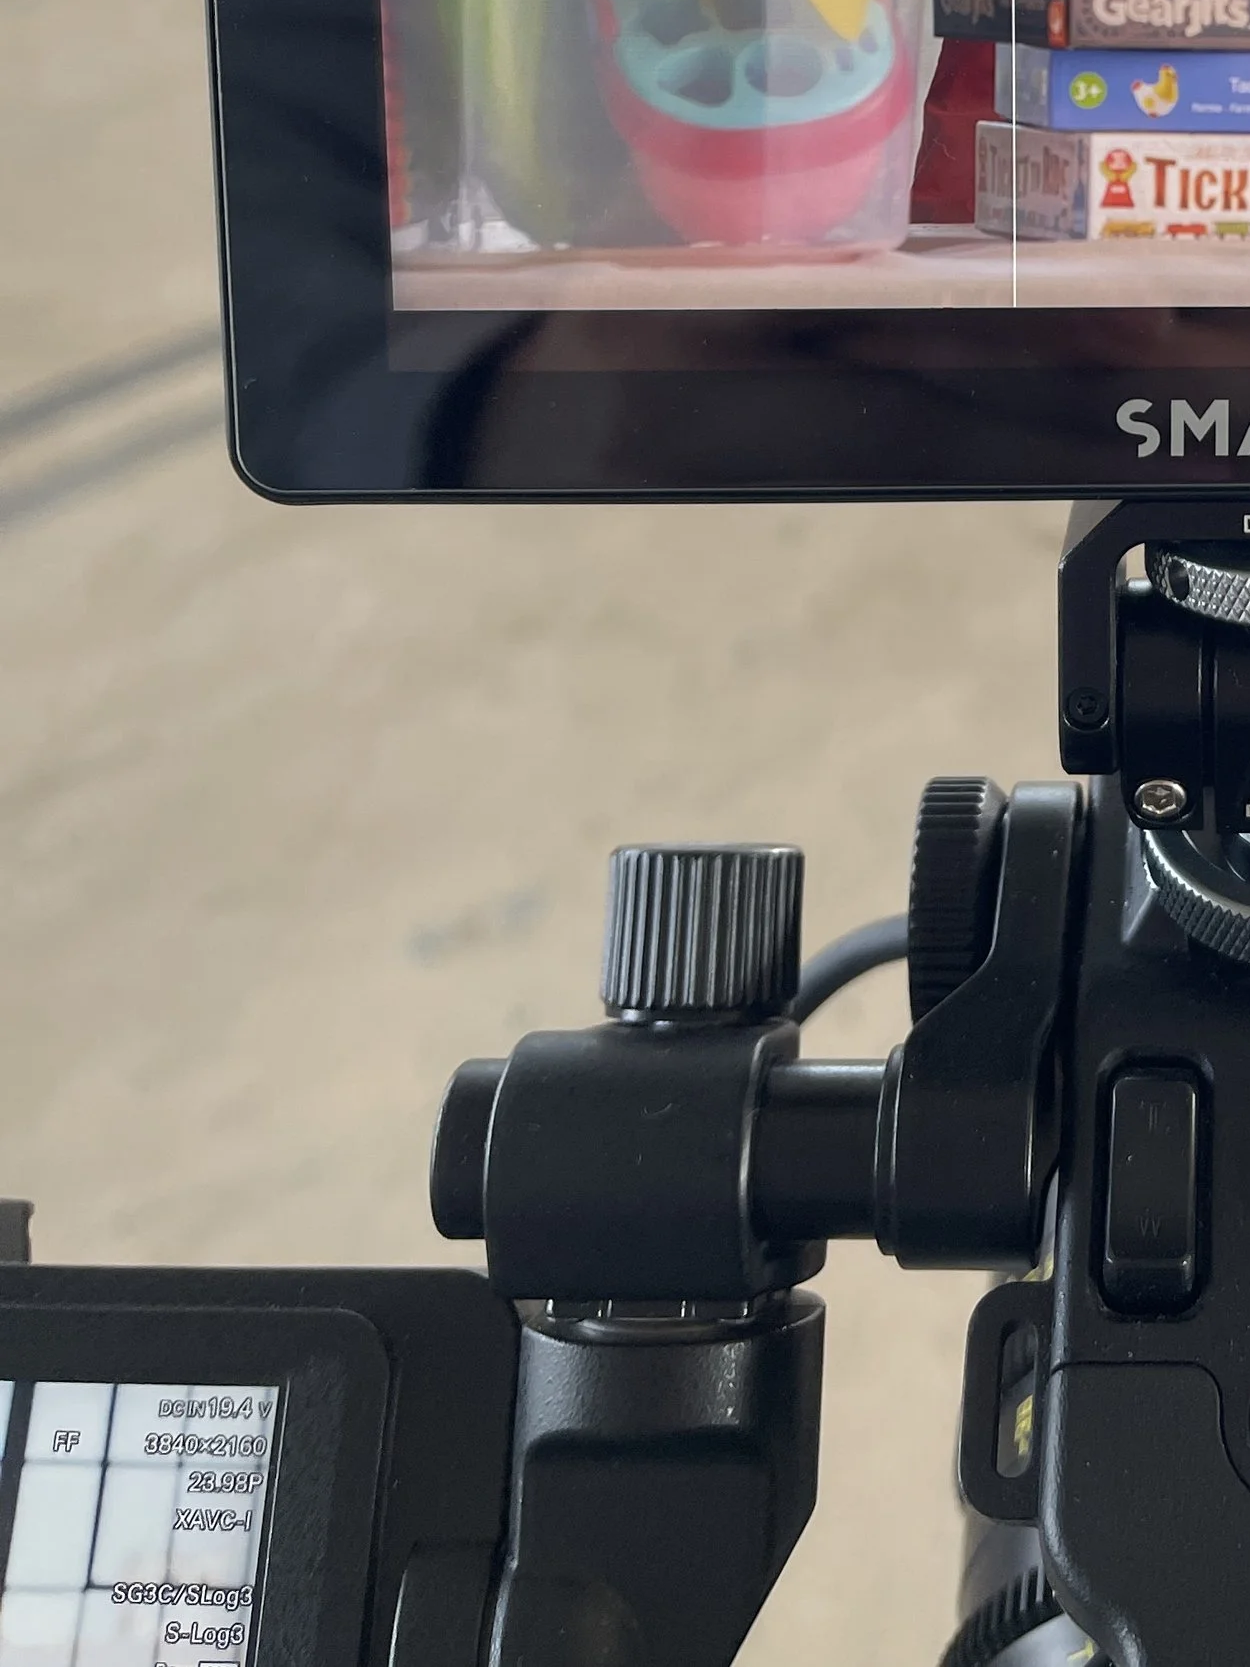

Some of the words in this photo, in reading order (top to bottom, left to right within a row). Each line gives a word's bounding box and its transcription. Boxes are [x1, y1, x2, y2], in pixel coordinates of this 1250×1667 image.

[53, 1430, 80, 1452] FF
[187, 1471, 264, 1494] 23.98P
[173, 1508, 253, 1531] XAVC-I
[111, 1582, 254, 1612] SG3C/SLog3
[164, 1621, 245, 1650] S-Log3
